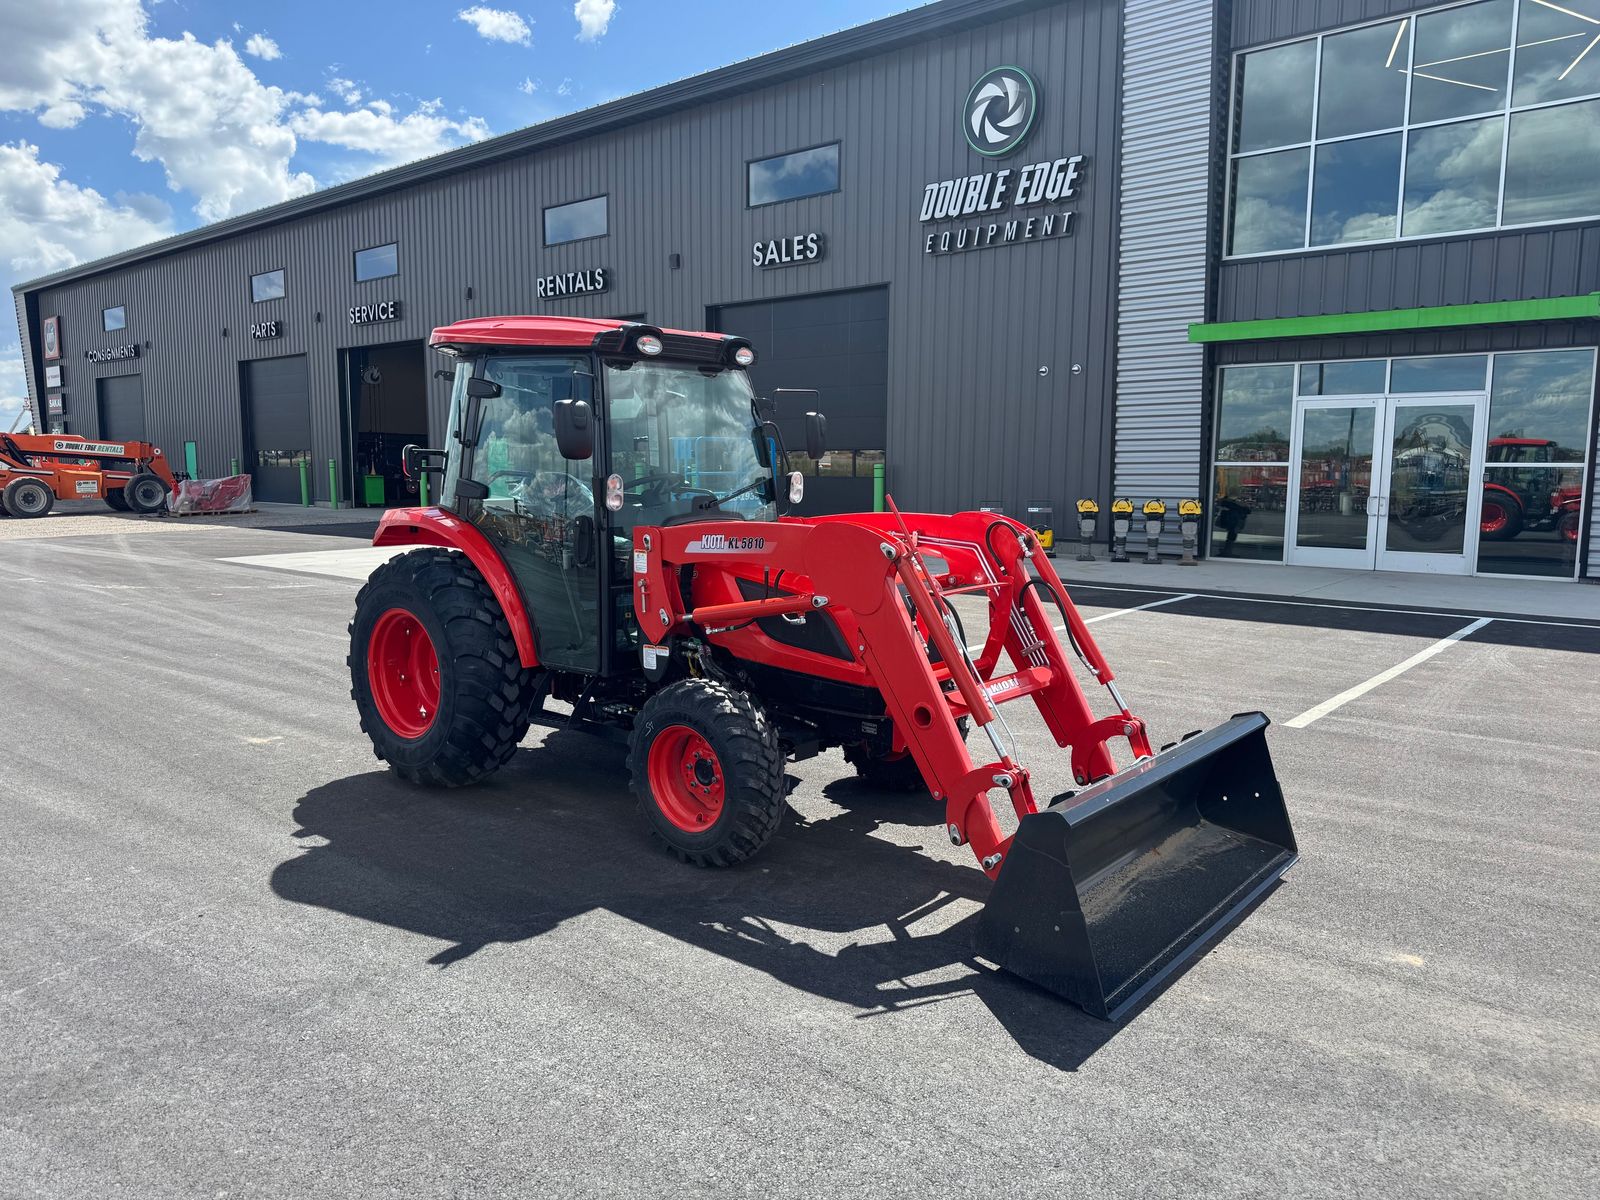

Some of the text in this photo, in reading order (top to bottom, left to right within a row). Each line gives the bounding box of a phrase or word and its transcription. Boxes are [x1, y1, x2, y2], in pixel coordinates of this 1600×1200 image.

[919, 155, 1083, 222] DOUBLE EDGE
[925, 211, 1073, 254] EQUIPMENT
[752, 232, 819, 267] SALES
[536, 267, 605, 298] RENTALS
[349, 301, 395, 325] SERVICE
[251, 320, 277, 339] PARTS
[88, 344, 135, 363] CONSIGNMENTS
[97, 445, 124, 454] RENTALS
[701, 534, 765, 549] KIOTI KL 5810
